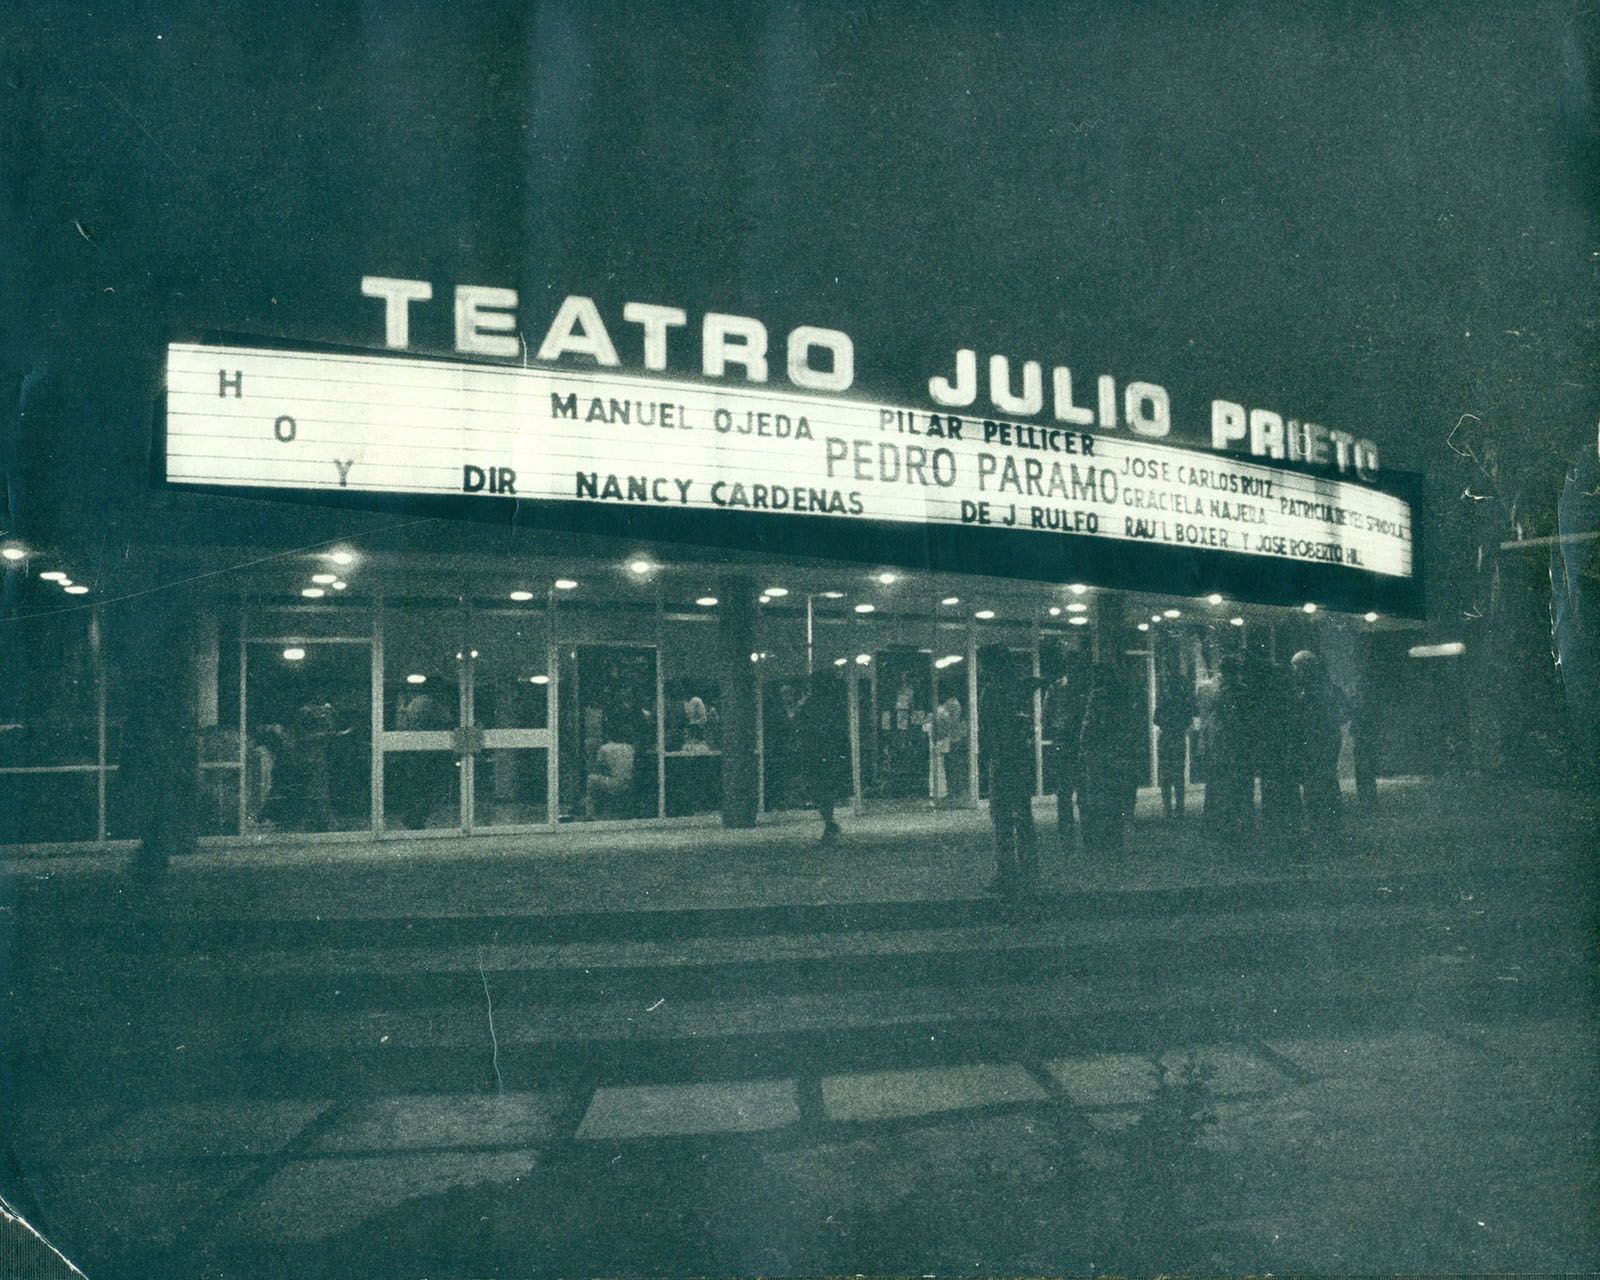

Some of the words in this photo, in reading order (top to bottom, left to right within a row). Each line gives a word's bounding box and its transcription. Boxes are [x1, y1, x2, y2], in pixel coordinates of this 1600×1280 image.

[361, 276, 854, 391] TEATRO
[928, 349, 1170, 437] JULIO
[1211, 399, 1379, 482] PRIETO
[551, 392, 693, 430] MANUEL
[713, 407, 814, 440] OJEDA
[880, 408, 963, 440] PILAR
[984, 420, 1095, 456] PELLICER
[463, 464, 517, 495] DIR
[576, 471, 693, 504] NANCY
[711, 481, 864, 515] CARDENAS
[825, 436, 957, 487] PEDRO
[978, 452, 1118, 504] PARAMO
[1120, 456, 1171, 482] JOSE
[1178, 465, 1238, 493] CARLOS
[1240, 475, 1274, 499] RUIZ
[961, 500, 991, 525] DE
[1003, 504, 1016, 527] J
[1031, 506, 1099, 533] RULFO
[1123, 487, 1204, 516] GRACIELA
[1280, 496, 1335, 524] PATRICIA
[1175, 523, 1228, 548] BOXER
[1241, 532, 1250, 550] Y
[1256, 535, 1287, 555] JOSE
[1290, 538, 1343, 563] ROBERTO
